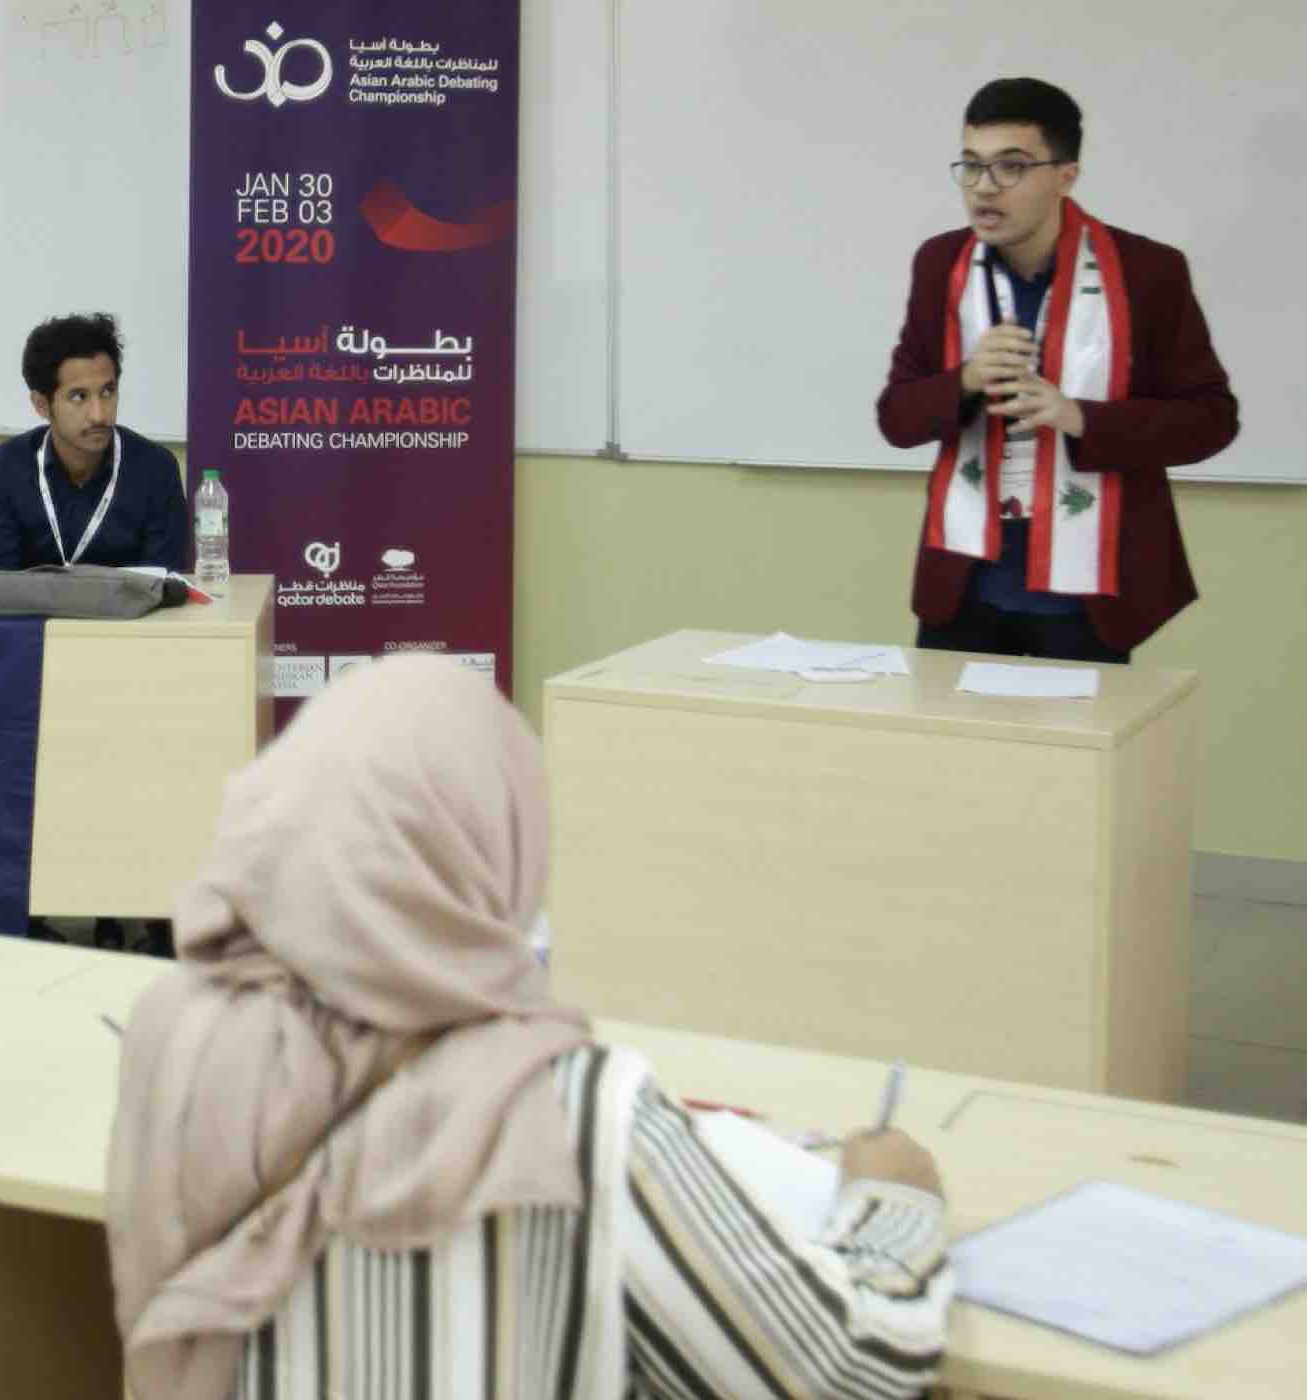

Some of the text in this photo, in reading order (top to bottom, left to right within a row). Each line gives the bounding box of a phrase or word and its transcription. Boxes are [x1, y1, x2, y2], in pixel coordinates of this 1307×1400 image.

[389, 38, 440, 54] بطولة
[349, 55, 499, 72] للمناظرات باللغة العربية
[349, 74, 499, 92] Asian Arabic Debating
[349, 89, 446, 106] Championship
[236, 172, 333, 197] JAN 30
[238, 199, 333, 224] FEB 03
[235, 228, 335, 264] 2020
[336, 325, 472, 361] بطولة
[236, 361, 472, 386] للمناظرات باللغة العربية
[233, 397, 471, 425] ASIAN ARABIC
[234, 432, 469, 449] DEBATING CHAMPIONSHIP
